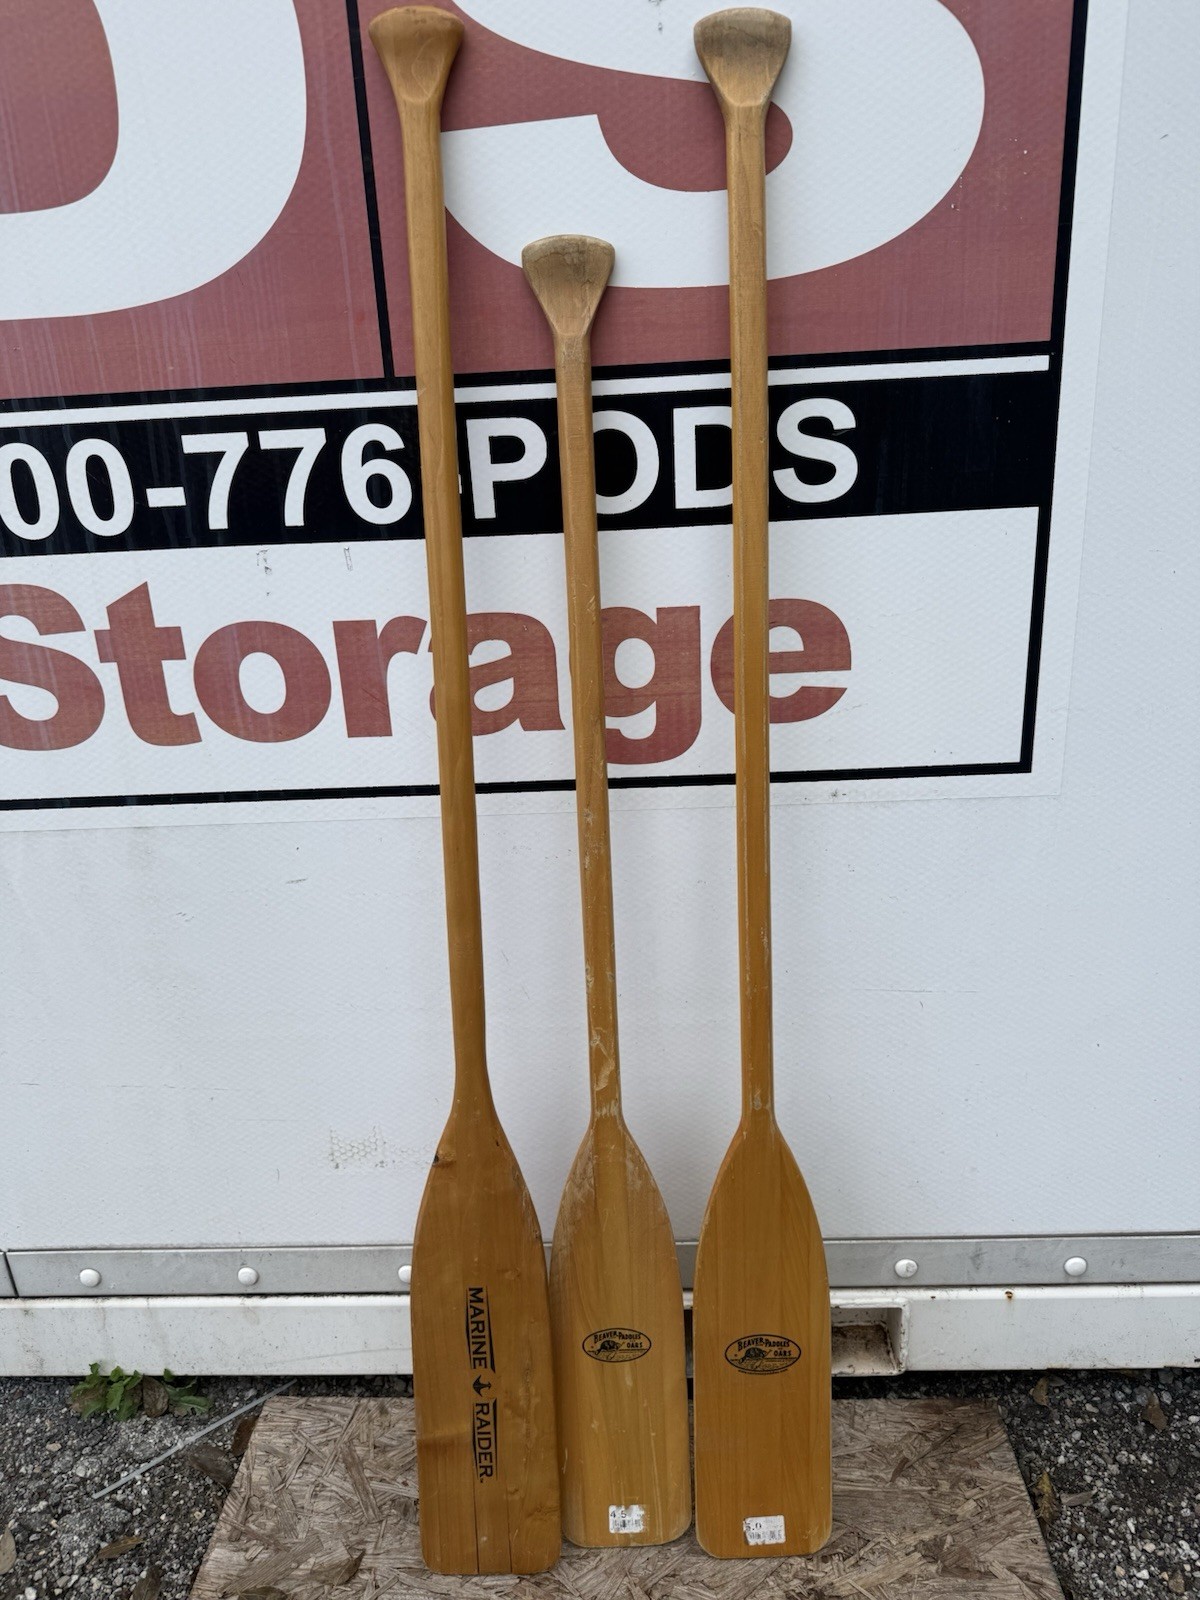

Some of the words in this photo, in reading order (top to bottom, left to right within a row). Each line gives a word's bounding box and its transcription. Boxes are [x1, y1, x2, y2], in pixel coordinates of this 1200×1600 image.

[0, 581, 852, 765] Storage
[468, 1286, 488, 1370] MARINE
[626, 1341, 643, 1349] OARS
[475, 1402, 494, 1479] RAIDER
